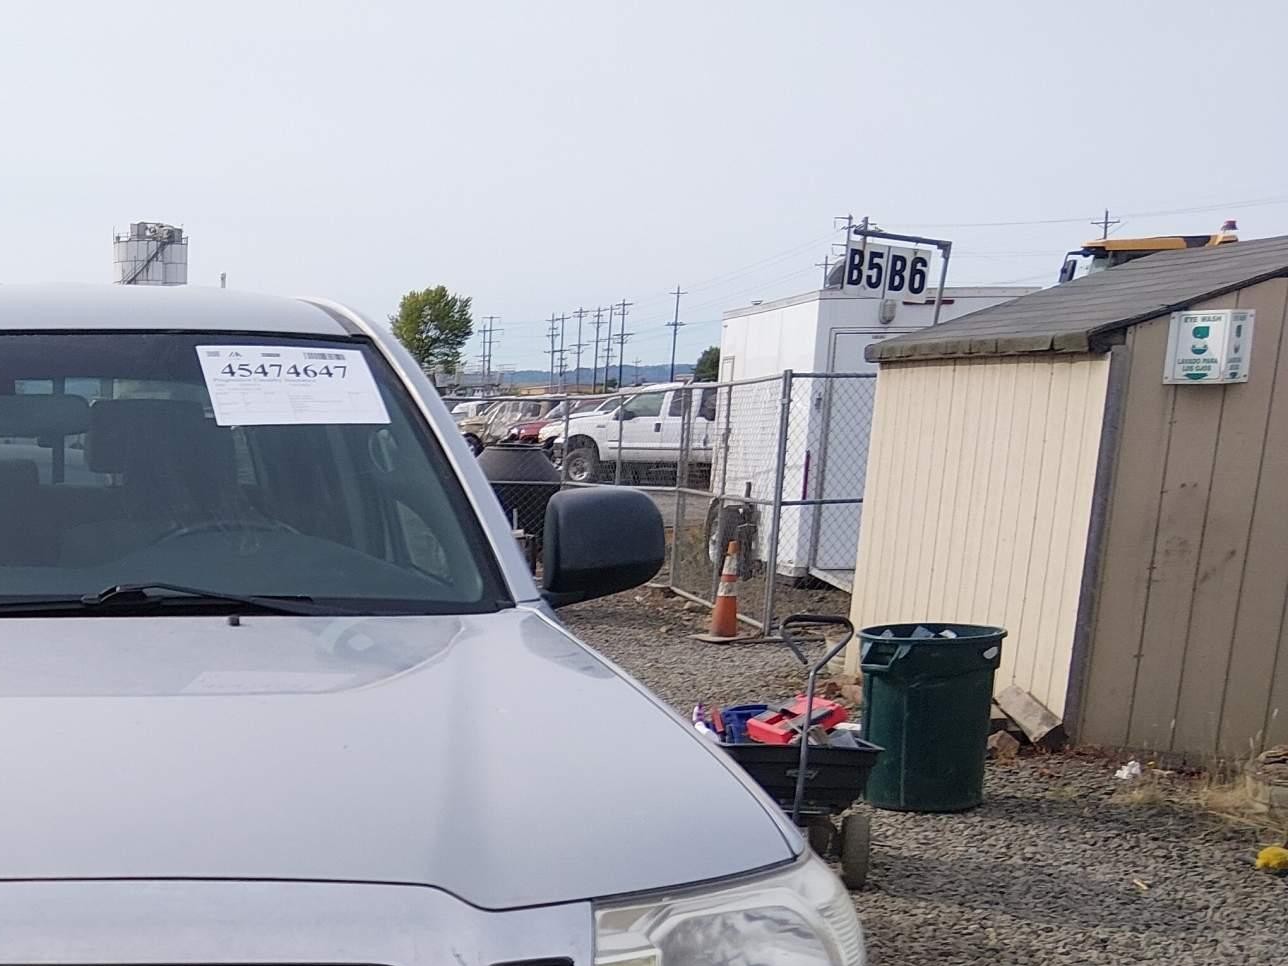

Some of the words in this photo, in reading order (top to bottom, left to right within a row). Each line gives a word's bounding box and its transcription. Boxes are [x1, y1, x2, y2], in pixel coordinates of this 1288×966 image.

[847, 248, 884, 289] B5
[888, 254, 928, 294] B6
[221, 363, 347, 379] 45474647
